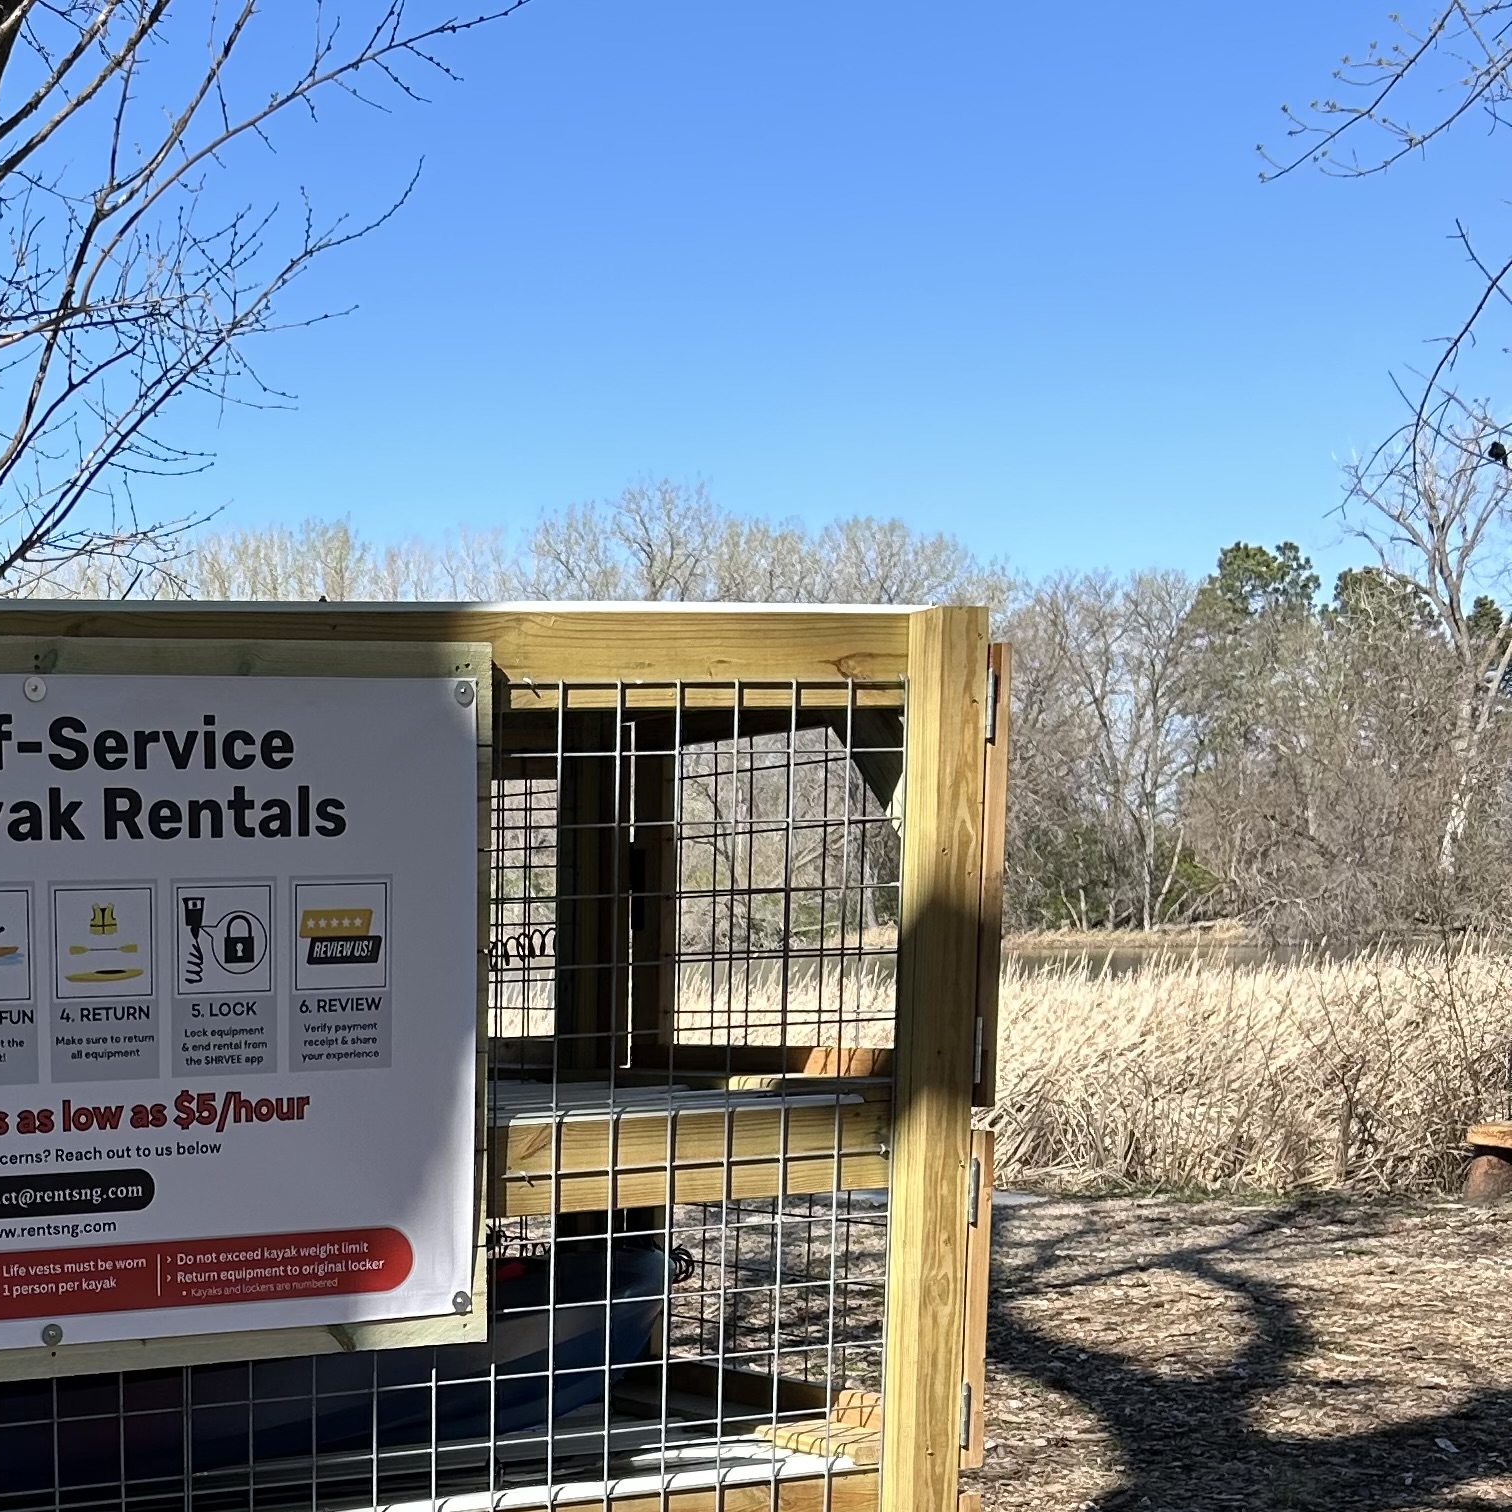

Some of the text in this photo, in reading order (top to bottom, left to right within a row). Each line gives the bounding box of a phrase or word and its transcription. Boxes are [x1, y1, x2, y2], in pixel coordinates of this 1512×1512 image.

[104, 785, 347, 840] Rentals
[313, 940, 373, 958] REVIEW US!
[191, 1001, 257, 1017] 5. LOCK
[299, 997, 382, 1014] 6. REVIEW
[0, 1009, 34, 1025] FUN
[60, 1005, 150, 1023] 4. RETURN
[184, 1026, 264, 1038] Lock equipment
[303, 1022, 377, 1034] Verify payment
[8, 1038, 24, 1048] the
[55, 1034, 155, 1046] Make sure to return
[182, 1040, 267, 1052] & end rental from
[303, 1036, 377, 1047] receipt & share
[71, 1048, 140, 1060] all equipment
[185, 1055, 264, 1066] the SHRVEE app
[302, 1050, 380, 1063] your experience
[16, 1109, 54, 1134] as
[62, 1099, 124, 1132] low
[130, 1103, 167, 1129] as
[174, 1090, 310, 1132] $5/hour
[55, 1147, 102, 1162] Reach
[106, 1146, 131, 1159] out
[135, 1144, 151, 1158] to
[155, 1145, 172, 1157] us
[177, 1141, 222, 1156] below
[177, 1242, 369, 1265] Do not exceed kayak weight limit
[2, 1257, 146, 1278] Life vests must be worn
[177, 1259, 384, 1283] Return equipment to original locker
[2, 1276, 117, 1298] 1 person per kayak
[191, 1278, 337, 1299] Kayaks and lockers are numbered
